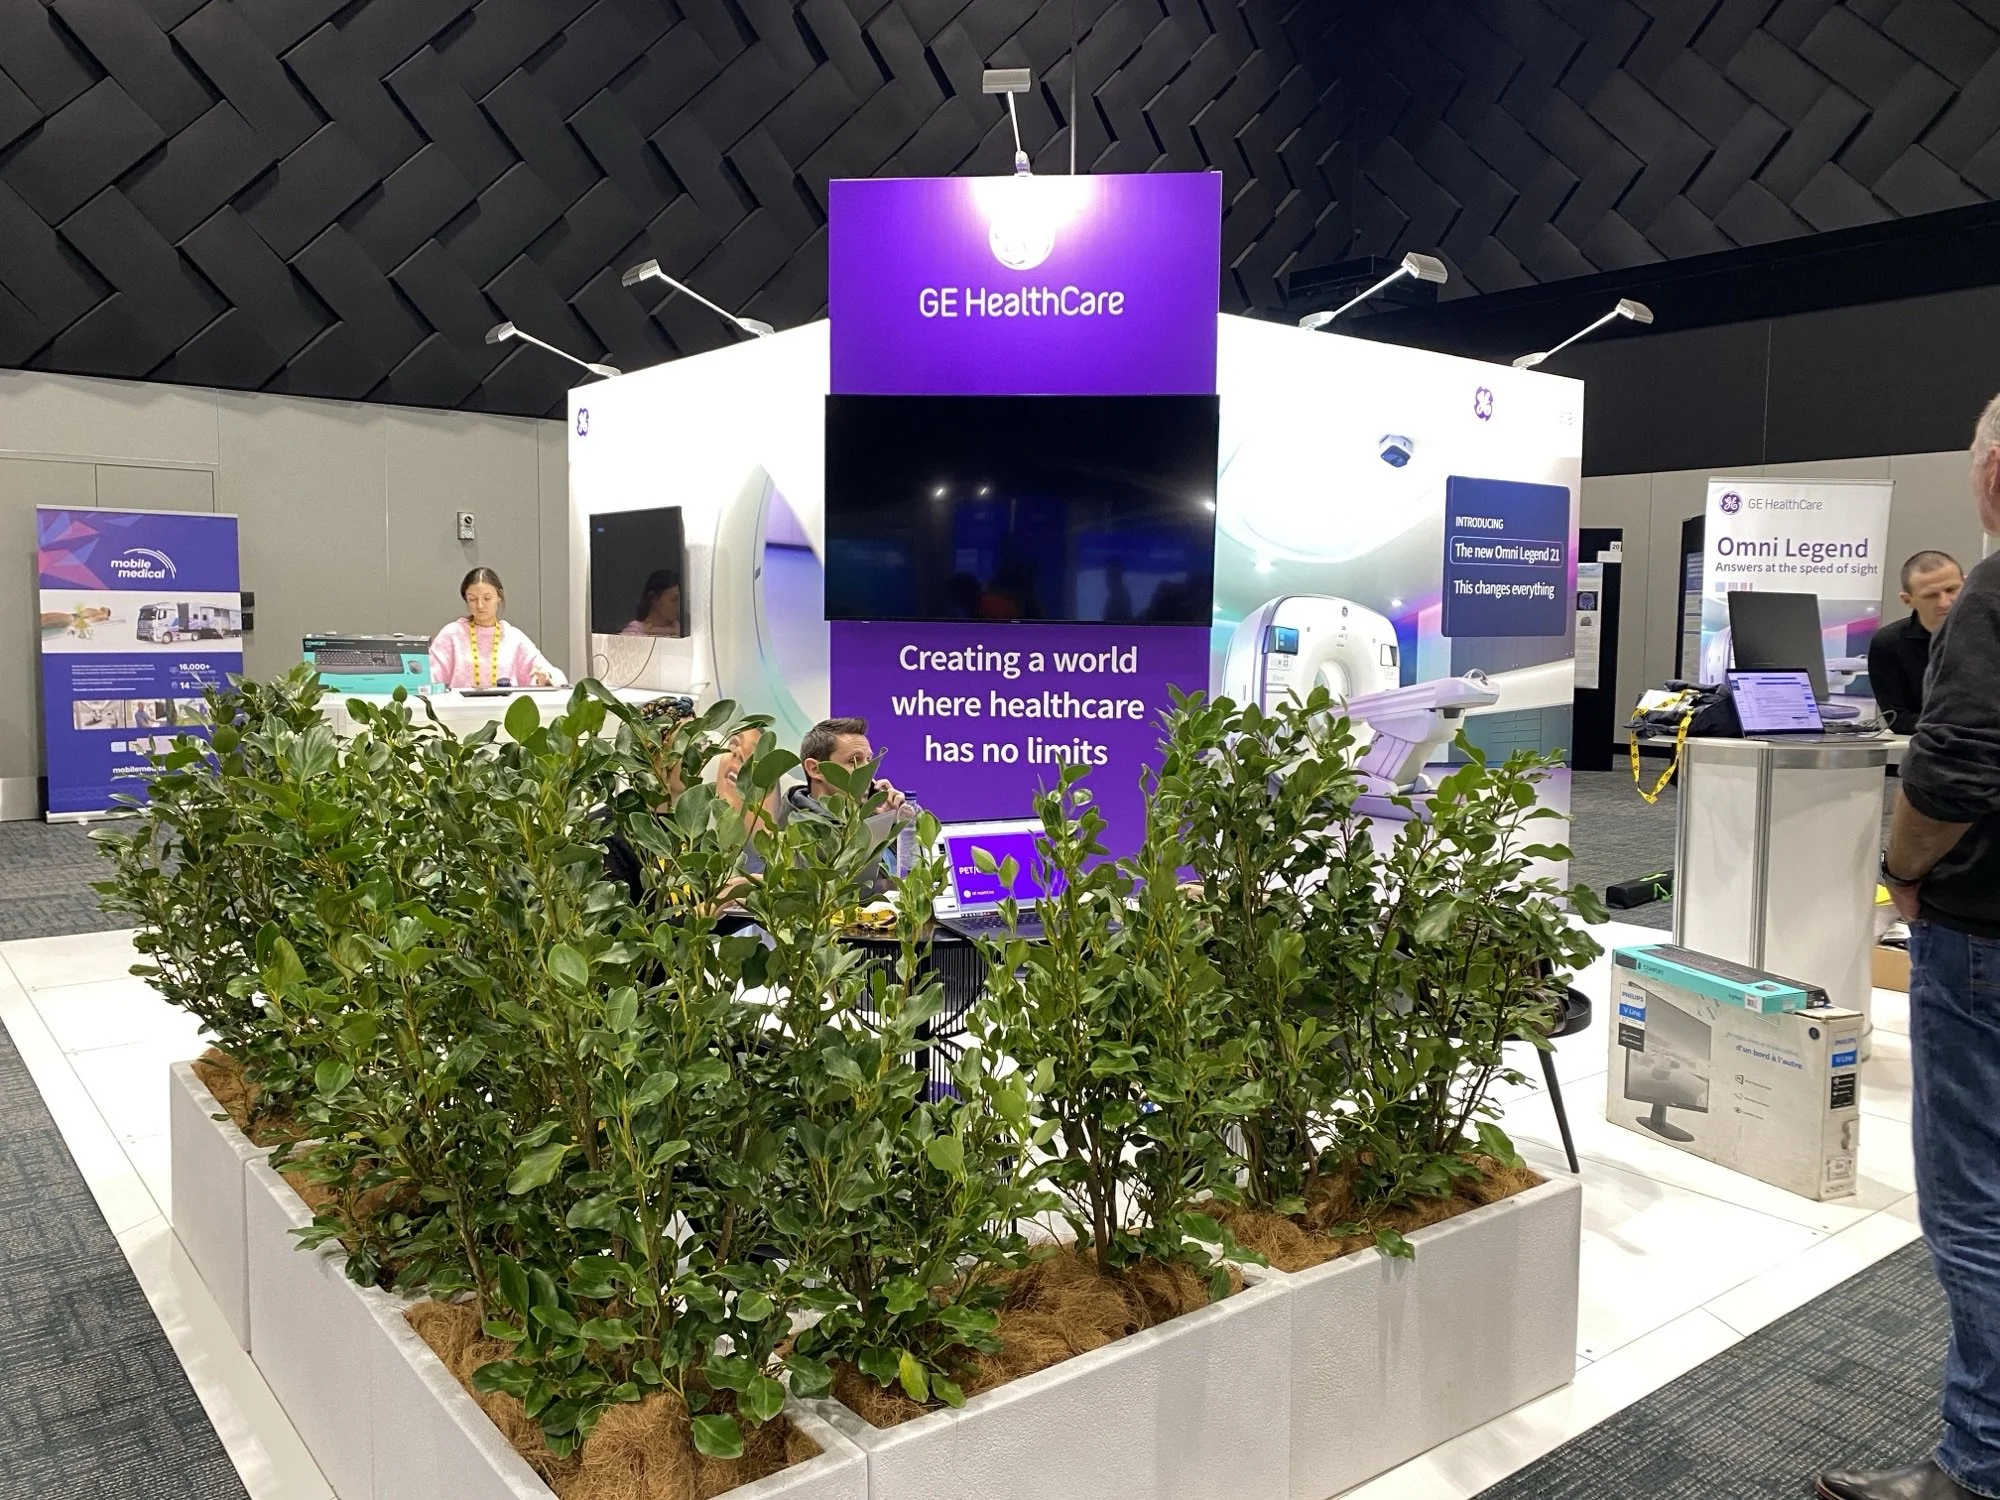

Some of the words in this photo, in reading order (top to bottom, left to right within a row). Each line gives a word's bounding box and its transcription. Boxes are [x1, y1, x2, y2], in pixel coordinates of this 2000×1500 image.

[919, 287, 958, 317] GE
[965, 285, 1125, 317] HealthCare
[1748, 498, 1763, 509] GE
[1765, 498, 1823, 510] HealthCare
[1455, 516, 1504, 529] INTRODUCING
[1455, 542, 1473, 558] The
[1474, 547, 1493, 559] new
[1495, 545, 1518, 560] Omni
[1520, 547, 1549, 564] Legend
[1550, 548, 1560, 561] 21
[1717, 536, 1778, 557] Omni
[1786, 538, 1869, 563] Legend
[110, 558, 151, 569] mobile
[1715, 562, 1763, 572] Answers
[1765, 563, 1776, 572] at
[1778, 563, 1797, 573] the
[1799, 563, 1833, 575] speed
[1836, 563, 1848, 574] of
[1851, 563, 1878, 576] sight
[118, 568, 165, 579] medical
[1453, 579, 1473, 594] This
[1474, 580, 1510, 599] changes
[1511, 582, 1555, 600] everything
[179, 663, 210, 671] 16,000+
[899, 644, 1021, 679] Creating
[1028, 651, 1044, 672] a
[1053, 645, 1137, 673] world
[180, 681, 190, 690] 14
[891, 689, 981, 717] where
[990, 690, 1145, 720] healthcare
[925, 735, 975, 763] has
[982, 743, 1019, 763] no
[1027, 736, 1108, 765] limits
[1621, 991, 1644, 1002] PHILIPS
[1629, 1007, 1641, 1017] Line
[1736, 1044, 1752, 1054] d'un
[1753, 1049, 1770, 1060] bord
